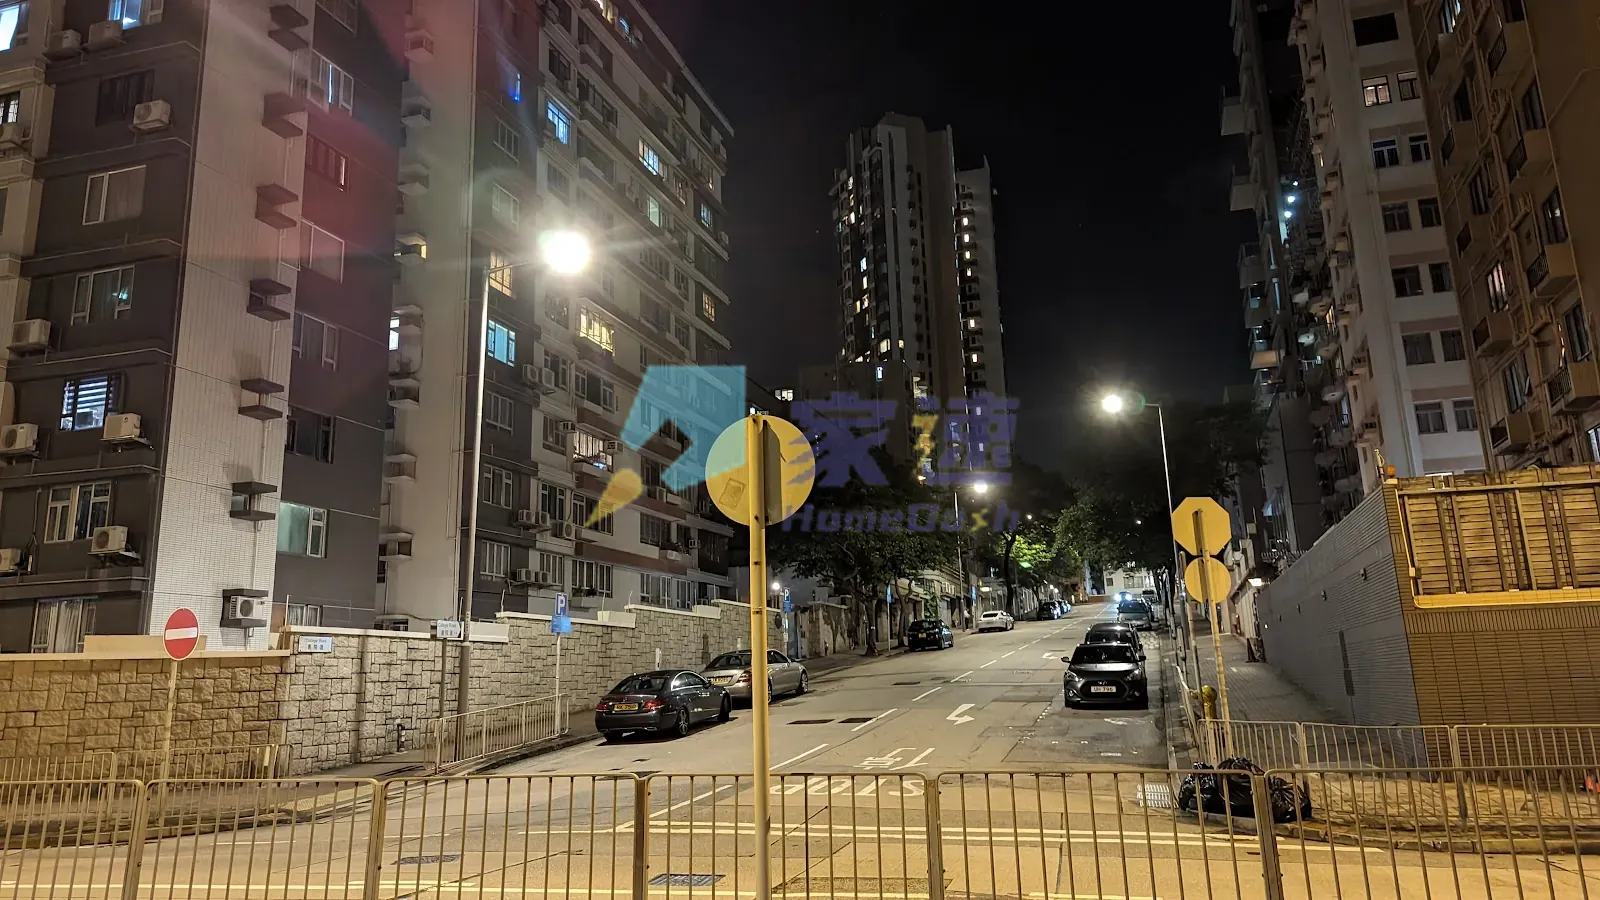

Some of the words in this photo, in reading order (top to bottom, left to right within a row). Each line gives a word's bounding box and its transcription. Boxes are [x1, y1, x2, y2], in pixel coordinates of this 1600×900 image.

[558, 595, 565, 613] P
[853, 748, 936, 771] 停
[769, 779, 925, 796] STOP
